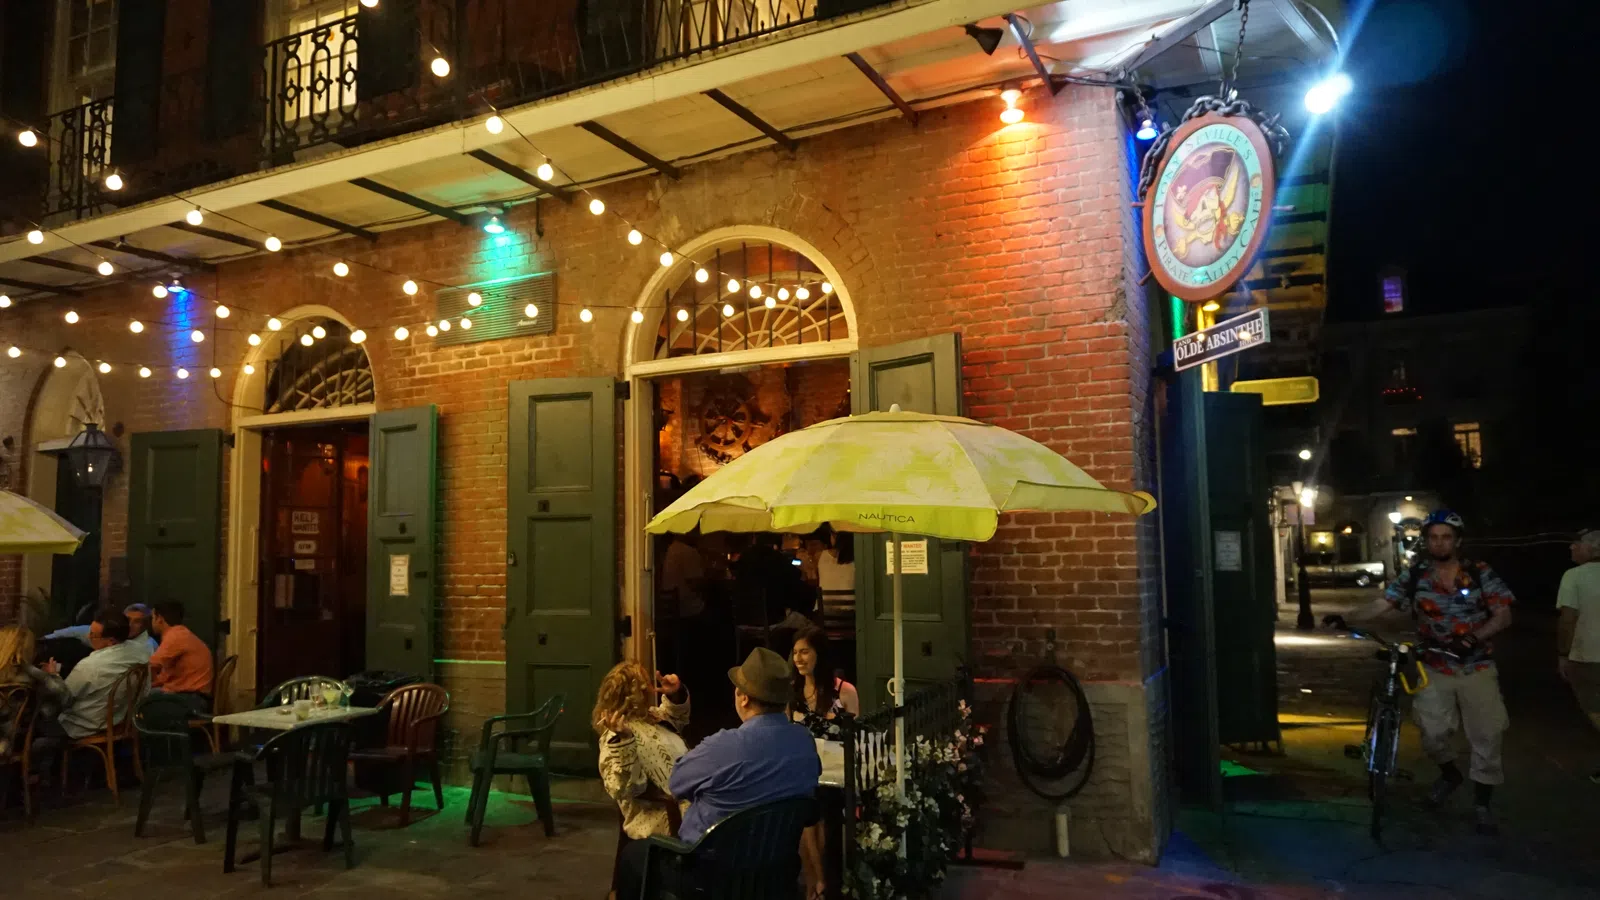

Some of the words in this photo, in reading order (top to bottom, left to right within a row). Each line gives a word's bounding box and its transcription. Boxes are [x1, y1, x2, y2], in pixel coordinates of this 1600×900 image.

[1200, 250, 1239, 284] ALLEY
[1176, 340, 1204, 360] OLDE
[1206, 318, 1262, 350] ABSINTHE
[1178, 338, 1192, 347] AND
[858, 513, 915, 523] NAUTICA
